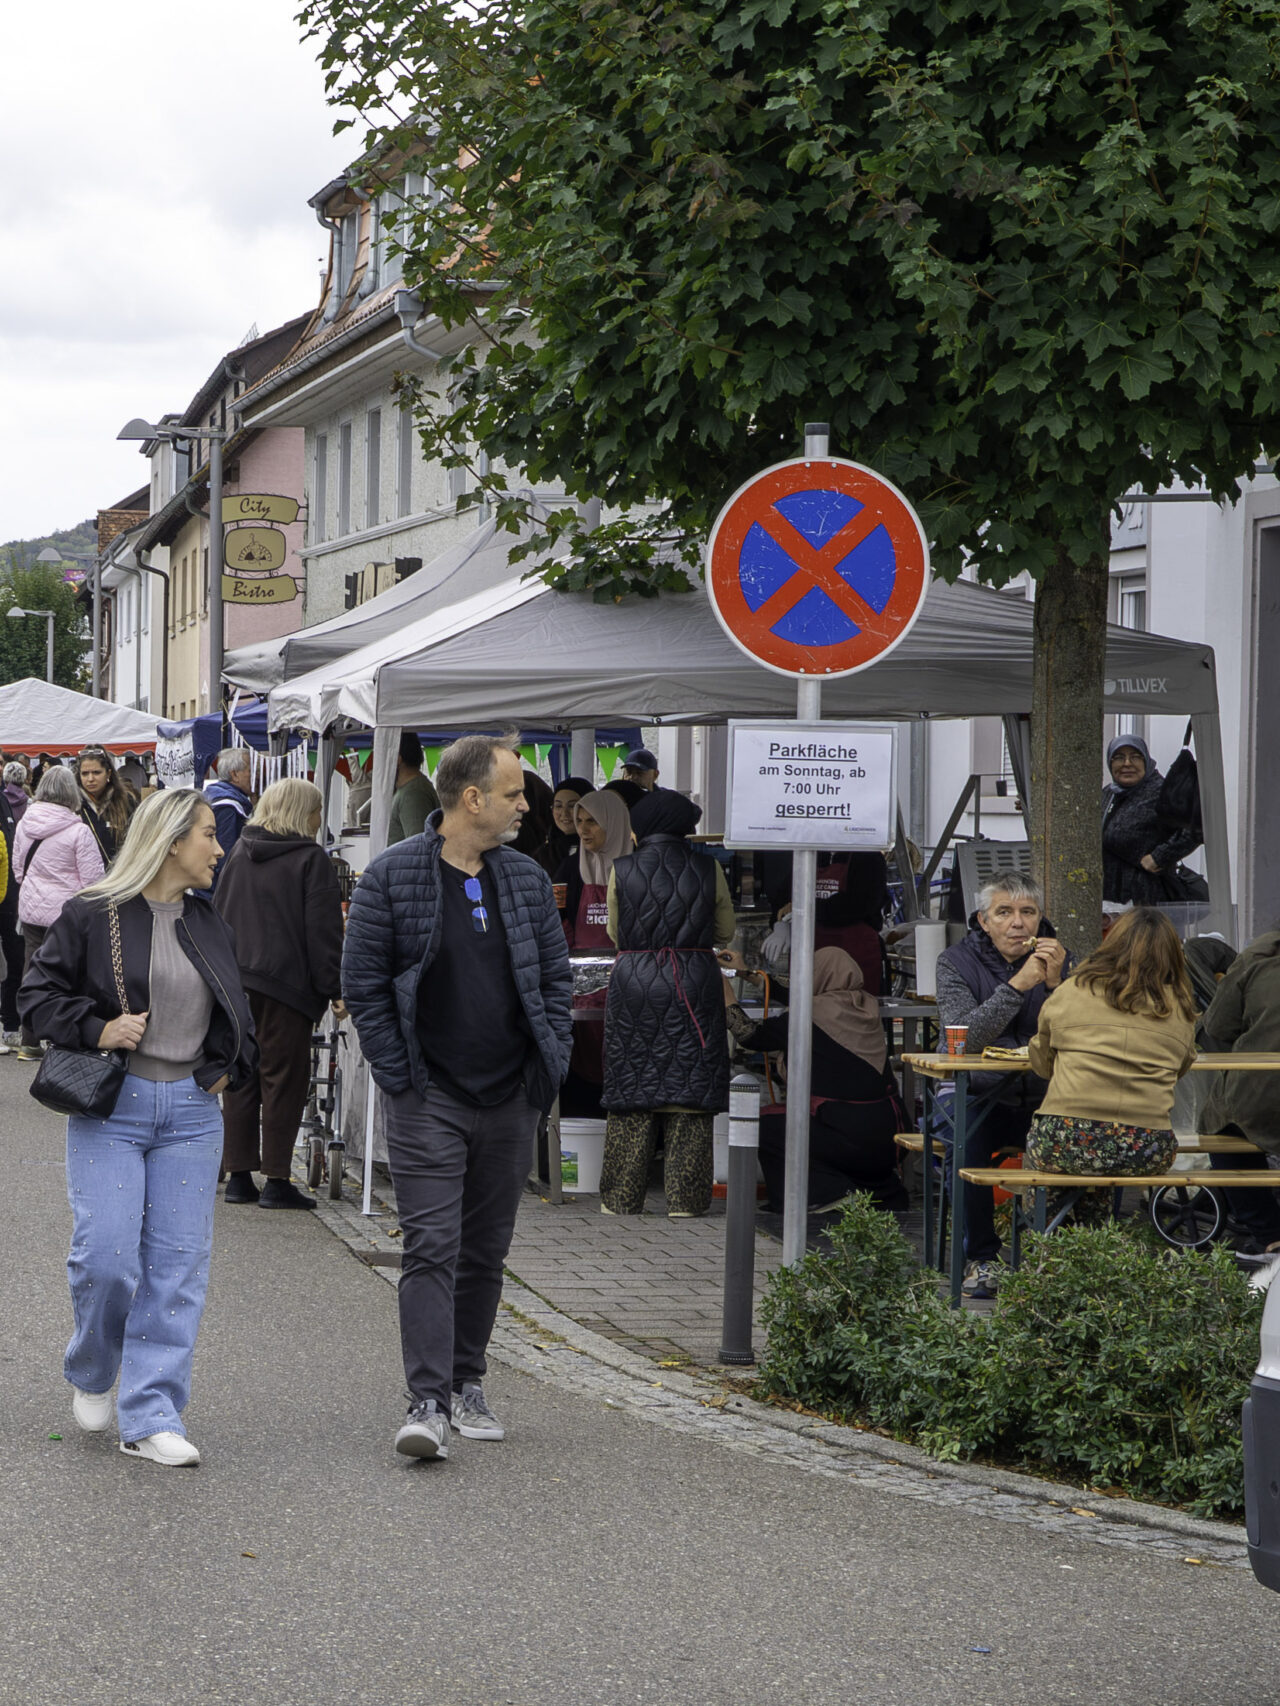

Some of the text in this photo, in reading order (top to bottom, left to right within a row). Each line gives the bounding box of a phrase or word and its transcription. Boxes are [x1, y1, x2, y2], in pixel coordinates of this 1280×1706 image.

[240, 497, 271, 520] City
[233, 581, 275, 598] Bistro
[1117, 678, 1168, 694] TILLVEX
[769, 743, 858, 759] Parkfläche
[759, 765, 866, 780] am Sonntag, ab
[783, 783, 841, 796] 7:00 Uhr
[775, 803, 851, 818] gesperrt!
